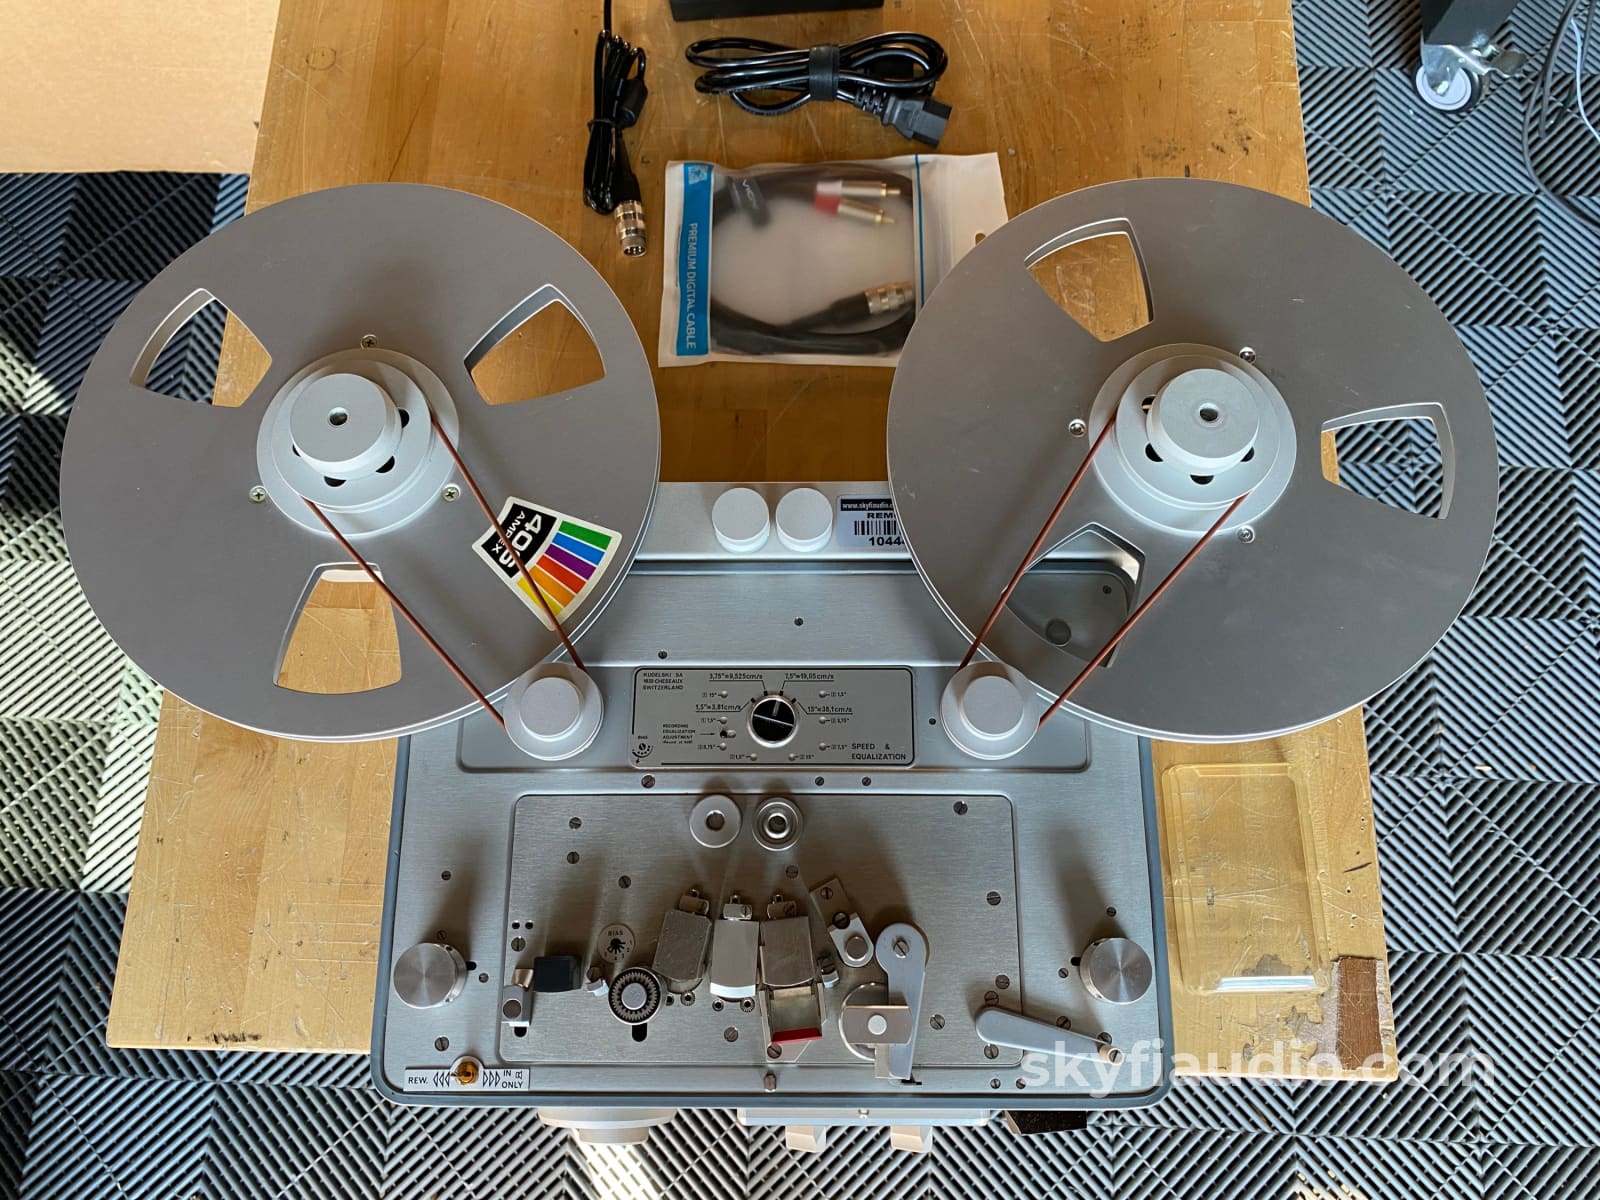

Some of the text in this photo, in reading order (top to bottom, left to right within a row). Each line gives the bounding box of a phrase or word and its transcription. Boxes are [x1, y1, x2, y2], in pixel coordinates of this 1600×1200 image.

[686, 222, 698, 350] PREMIUM DIGITAL CABLE
[851, 753, 907, 761] EQUALIZATION
[503, 1069, 512, 1077] IN
[408, 1076, 429, 1085] REW.
[501, 1081, 524, 1089] ONLY
